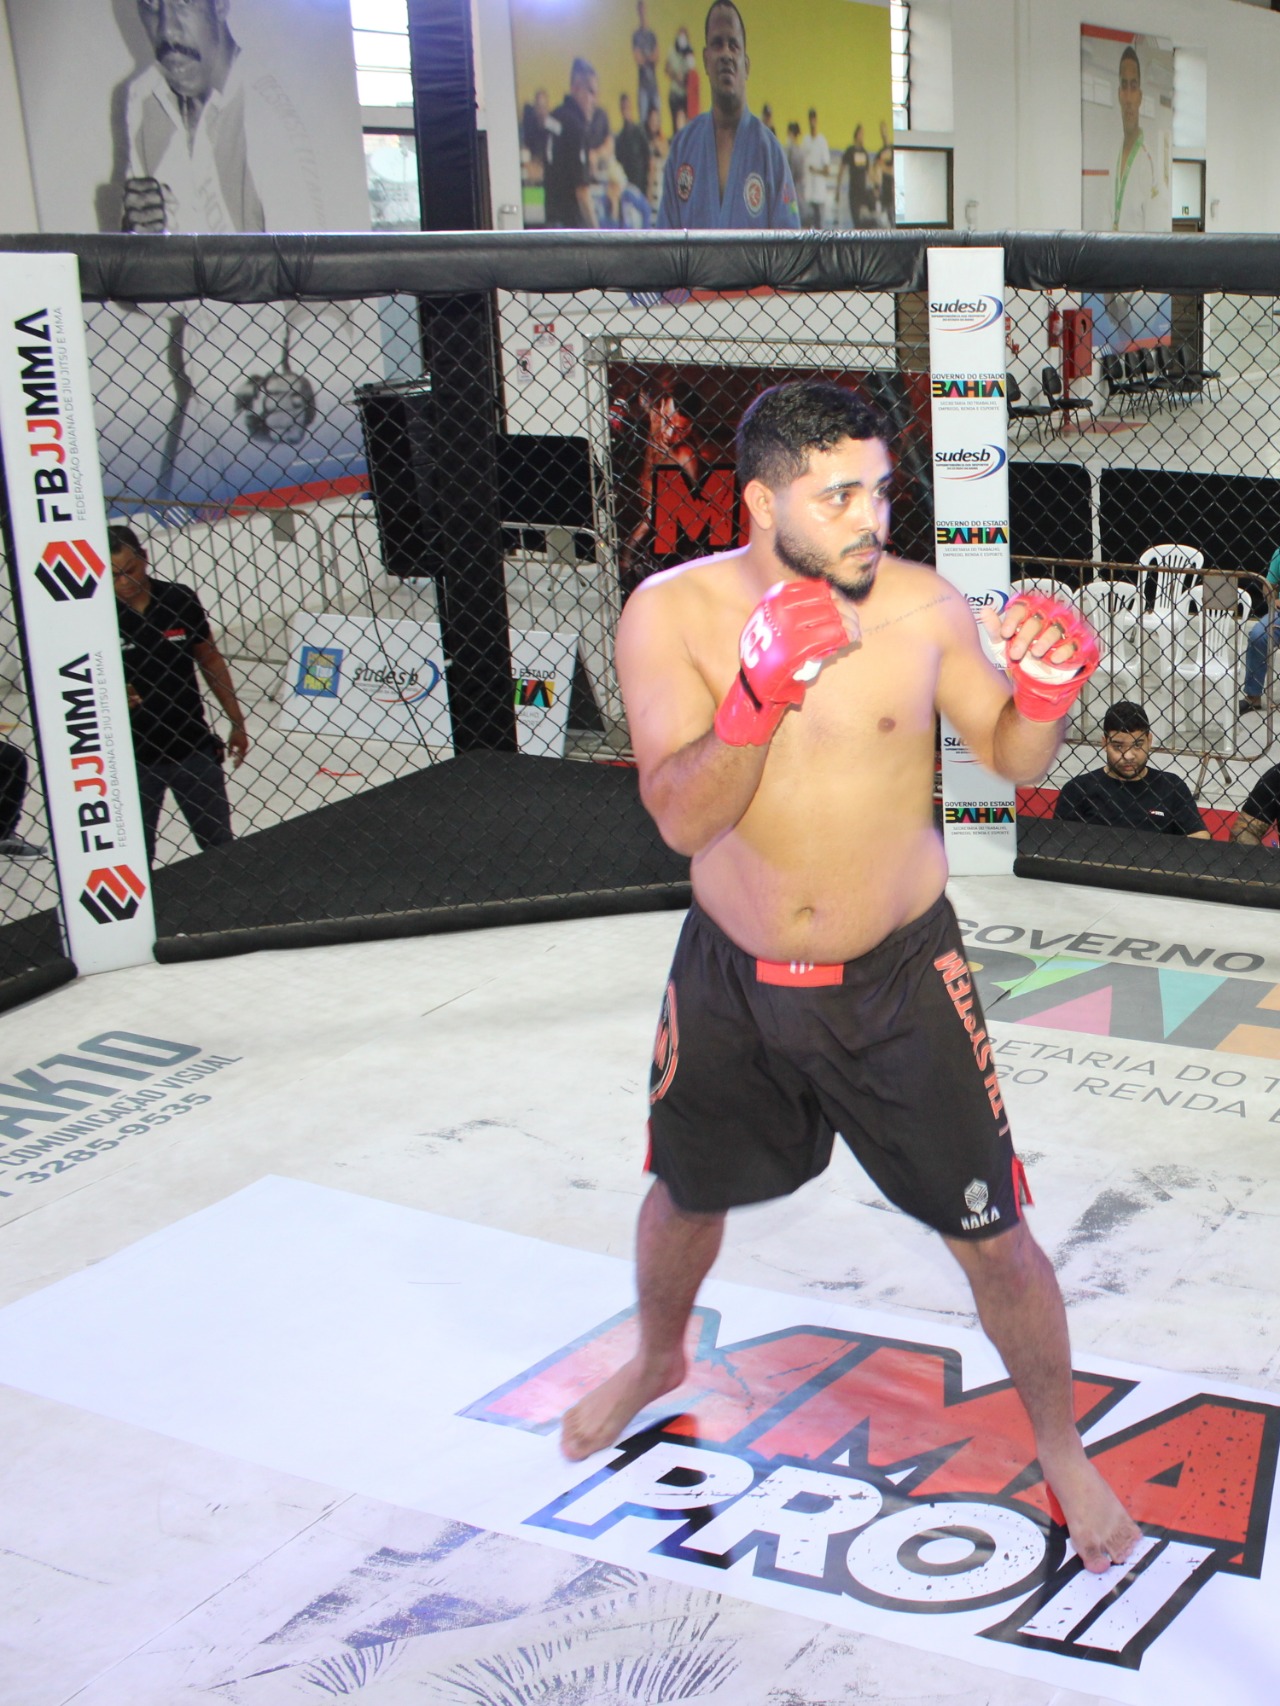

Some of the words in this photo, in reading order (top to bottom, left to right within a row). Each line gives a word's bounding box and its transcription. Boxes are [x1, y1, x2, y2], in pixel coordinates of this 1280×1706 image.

[53, 307, 66, 330] MMA
[930, 299, 987, 313] sudesb
[60, 346, 70, 375] JITSU
[63, 377, 72, 394] JIU
[932, 380, 1005, 398] BAHIA
[14, 308, 73, 523] FBJJMMA
[65, 396, 73, 412] DE
[67, 414, 79, 455] BAIANA
[935, 448, 991, 463] sudesb
[70, 456, 86, 521] FEDERAÇÃO
[936, 527, 1008, 544] BAHIA
[94, 651, 106, 676] MMA
[354, 665, 418, 686] sudesb
[99, 687, 110, 713] JITSU
[102, 715, 112, 731] JIU
[58, 653, 114, 853] FBJJMMA
[105, 733, 114, 749] DE
[108, 749, 120, 787] BAIANA
[112, 788, 126, 848] FEDERAÇÃO
[945, 808, 1015, 823] BAHIA
[957, 918, 1265, 974] GOVERNO
[154, 1055, 244, 1090] VISUAL
[1175, 1064, 1246, 1087] DO
[1073, 1077, 1247, 1118] RENDA
[15, 1093, 212, 1184] 3285-9535
[961, 1205, 1001, 1231] HAKA
[522, 1437, 1068, 1615] PRO
